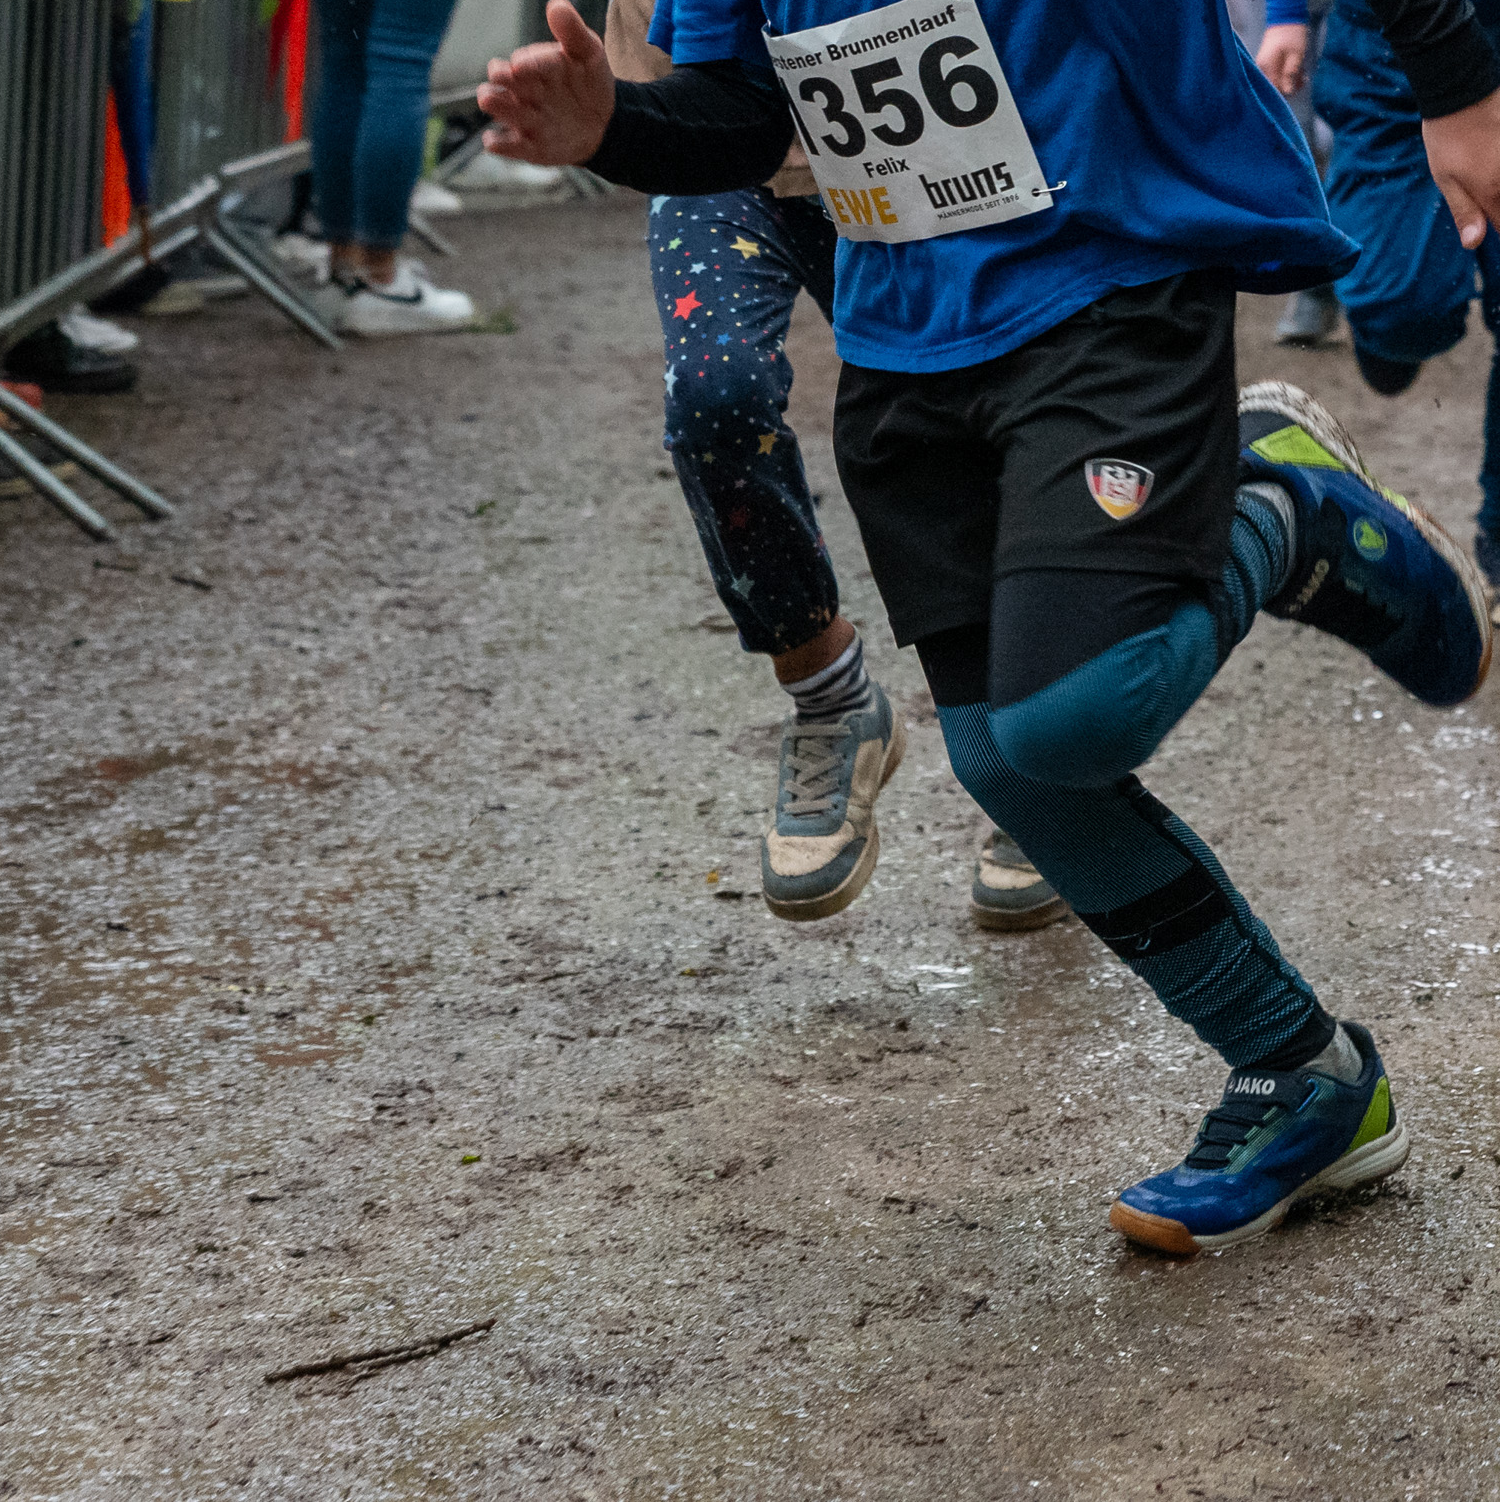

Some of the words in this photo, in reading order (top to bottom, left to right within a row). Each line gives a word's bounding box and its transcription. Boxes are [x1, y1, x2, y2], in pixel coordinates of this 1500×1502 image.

[826, 4, 956, 61] Brunnenlauf
[862, 157, 910, 178] Felix
[918, 161, 1015, 209] bruns
[827, 186, 898, 225] EWE
[984, 199, 1001, 210] SEIT
[1234, 1077, 1276, 1095] JAKO
